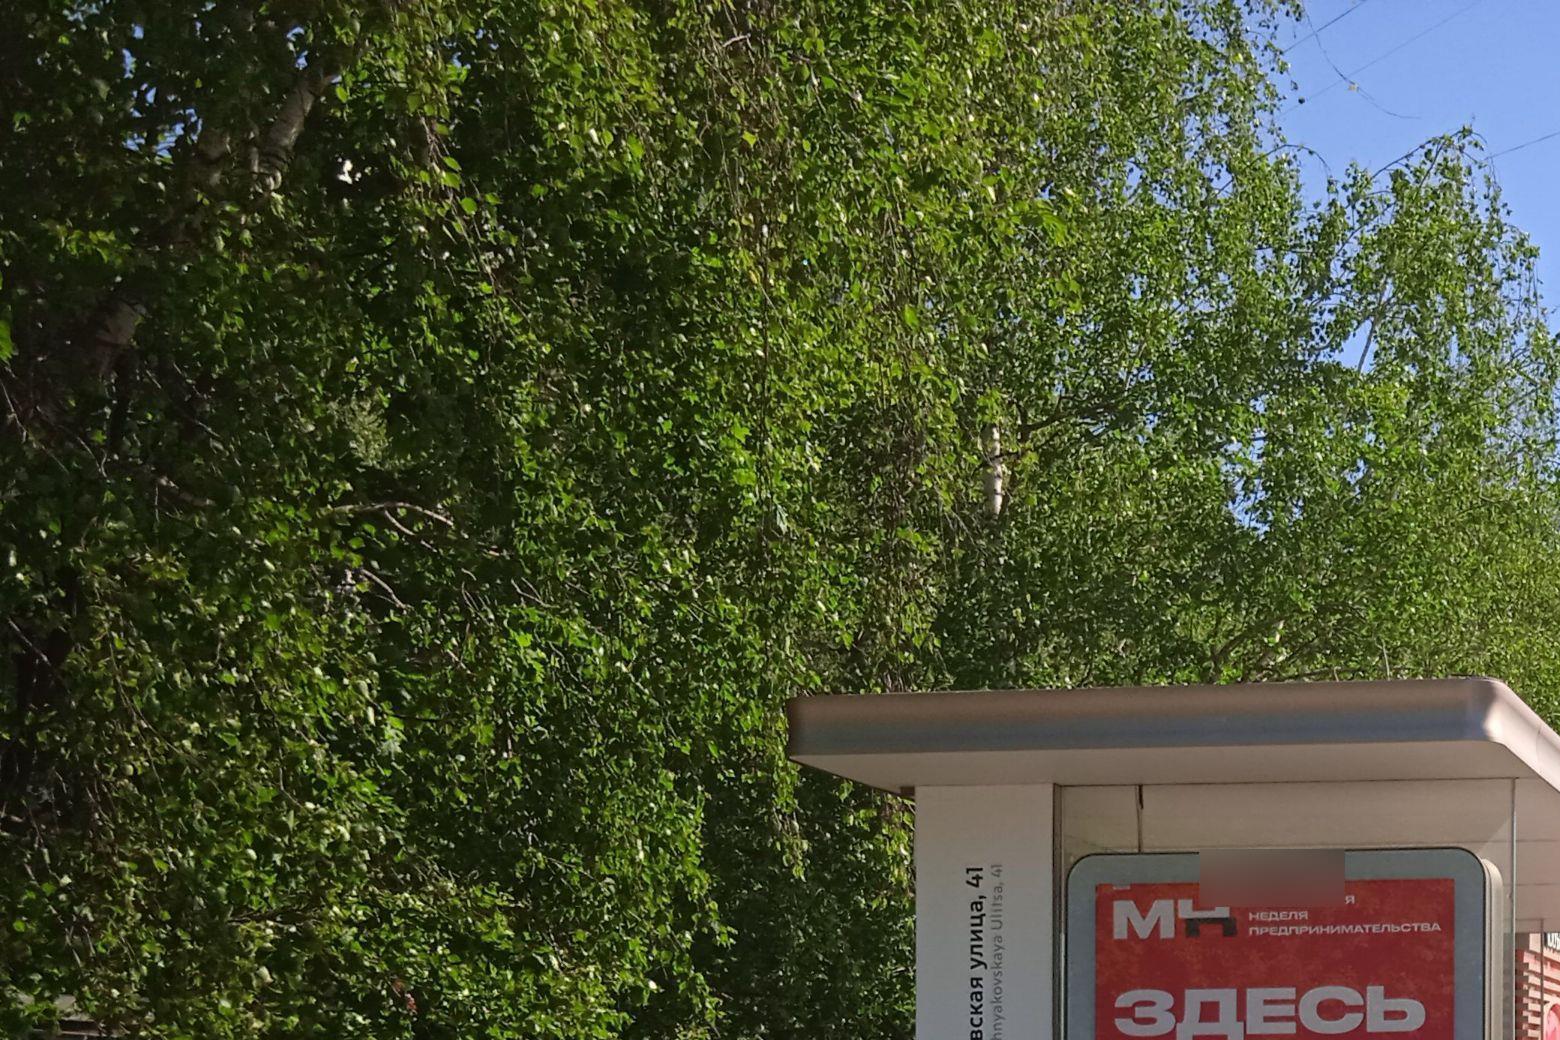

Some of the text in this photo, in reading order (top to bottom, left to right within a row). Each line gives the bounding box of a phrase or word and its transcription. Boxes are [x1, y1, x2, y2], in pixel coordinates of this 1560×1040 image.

[965, 866, 984, 888] 41
[990, 864, 1003, 878] 41
[990, 882, 1005, 931] Ulitsa,
[1248, 911, 1309, 922] НЕДЕЛЯ
[969, 894, 988, 970] улица,
[1248, 923, 1442, 937] ПРЕДПРИНИМАТЕЛЬСТВА
